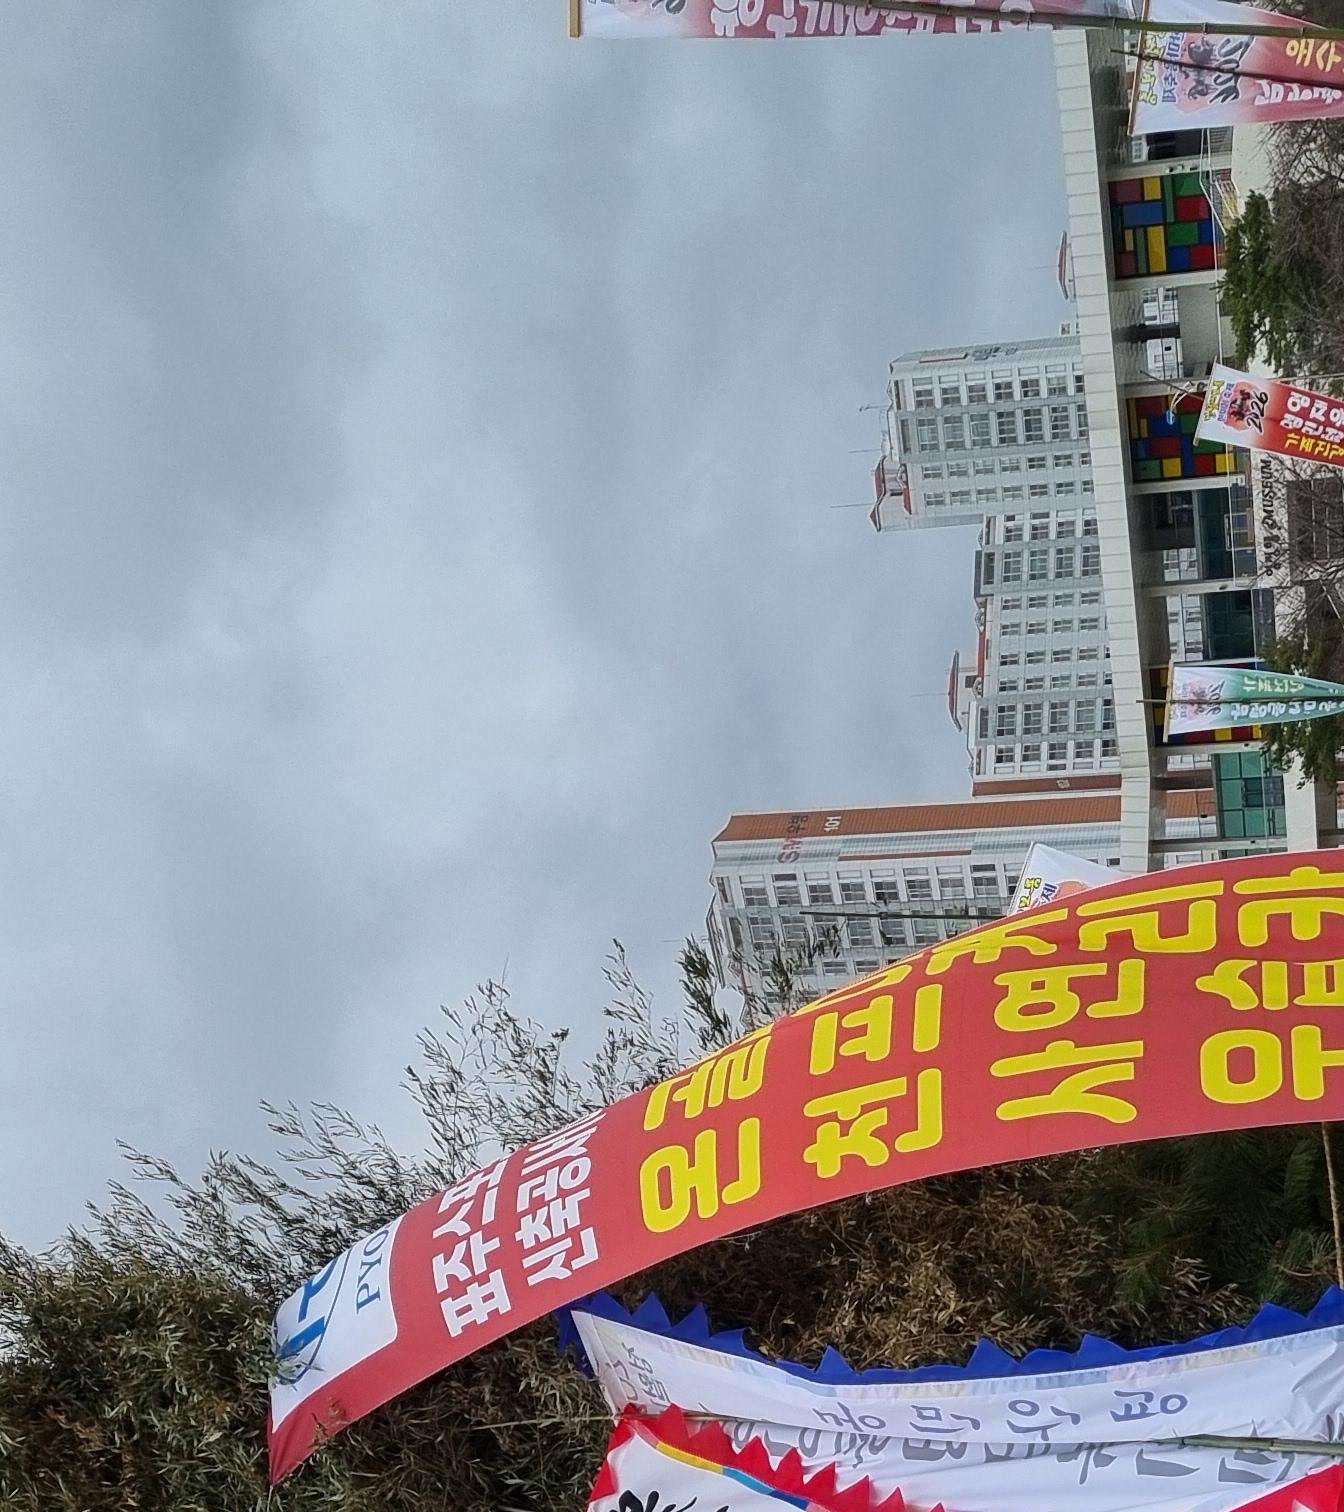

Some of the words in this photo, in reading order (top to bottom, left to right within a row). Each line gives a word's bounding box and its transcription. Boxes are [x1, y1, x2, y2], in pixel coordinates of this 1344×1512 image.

[1246, 390, 1269, 433] 2026
[1259, 458, 1276, 520] MUSEUM
[823, 815, 842, 831] 101
[517, 1108, 606, 1286] 신축공사
[355, 1221, 393, 1315] PYO
[432, 1159, 514, 1338] 표주스포
